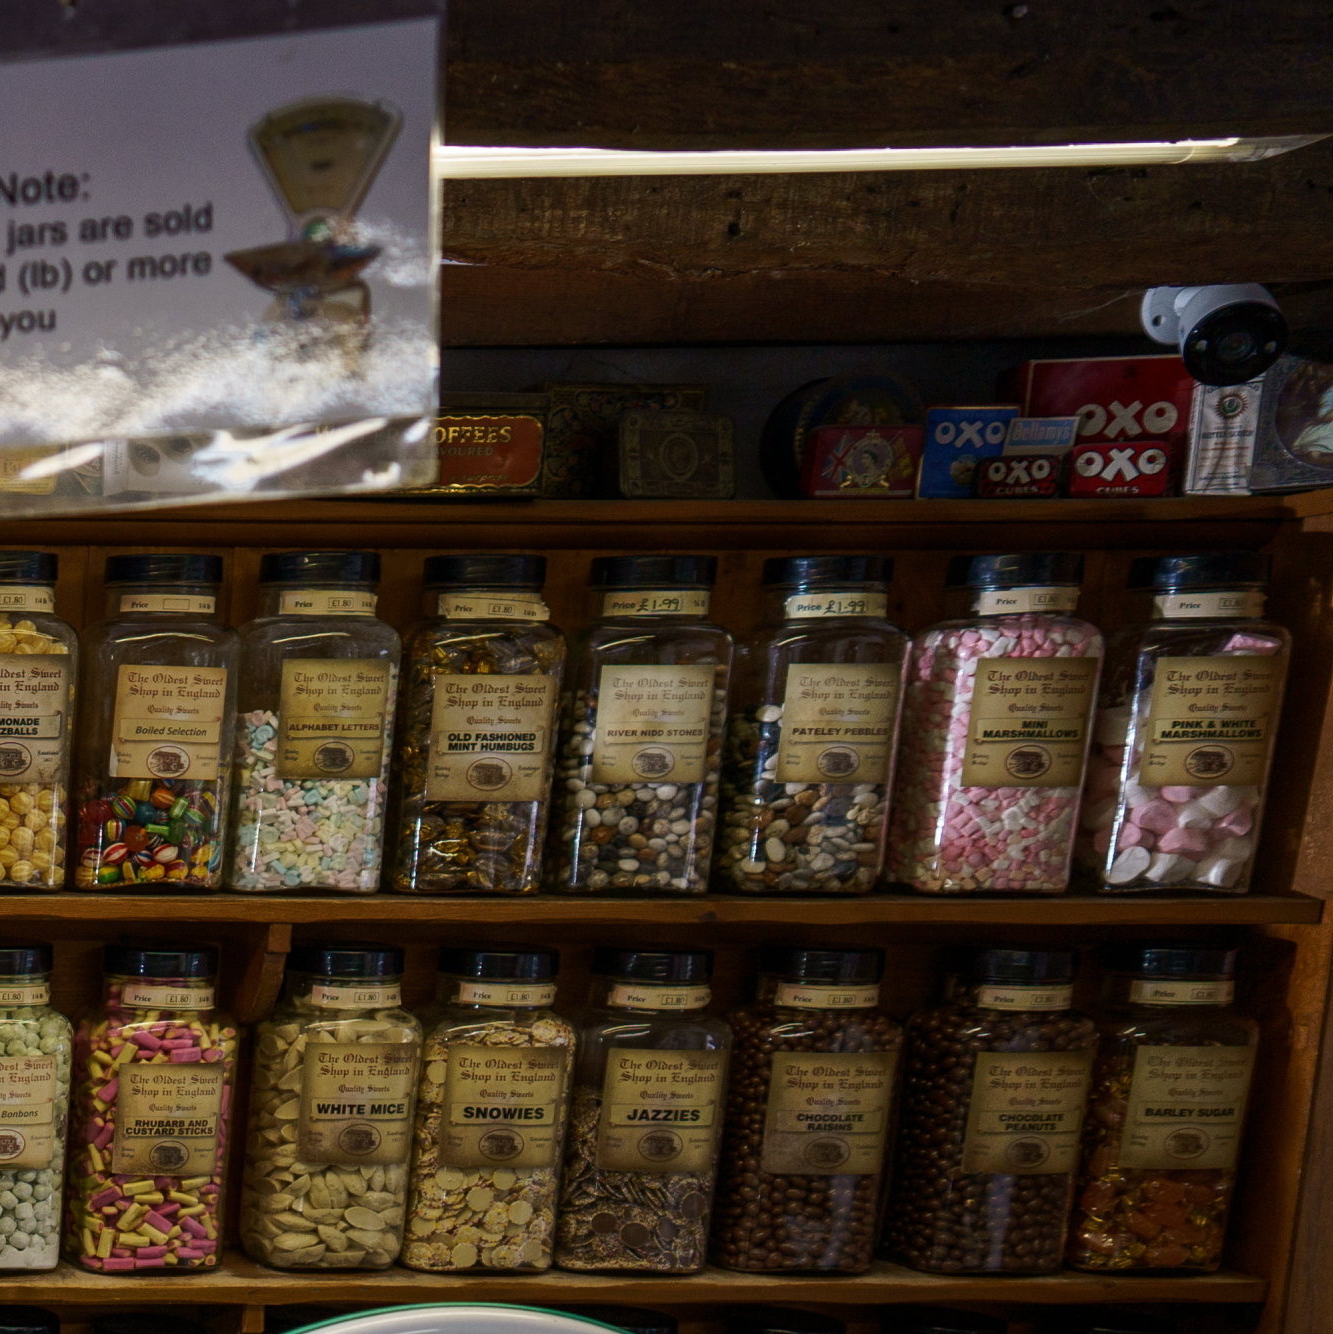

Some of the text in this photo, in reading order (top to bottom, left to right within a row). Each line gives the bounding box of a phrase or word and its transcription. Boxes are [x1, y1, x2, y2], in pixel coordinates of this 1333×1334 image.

[5, 220, 69, 256] jars
[80, 219, 132, 243] are
[145, 204, 213, 237] sold
[20, 258, 72, 294] (lb)
[83, 257, 116, 286] or
[127, 251, 212, 282] more
[1075, 400, 1178, 439] OXO
[935, 421, 1007, 448] OXO
[1075, 448, 1166, 481] OXO
[988, 459, 1051, 484] OXO
[135, 727, 207, 736] Boiled Selection
[448, 733, 536, 742] OLD FASHIONED
[447, 742, 535, 751] MINT HUMBUGS
[1, 1109, 38, 1120] Bonbons
[317, 1103, 404, 1115] WHITE MICE
[463, 1107, 544, 1120] SNOWIES
[627, 1109, 700, 1122] JAZZIES
